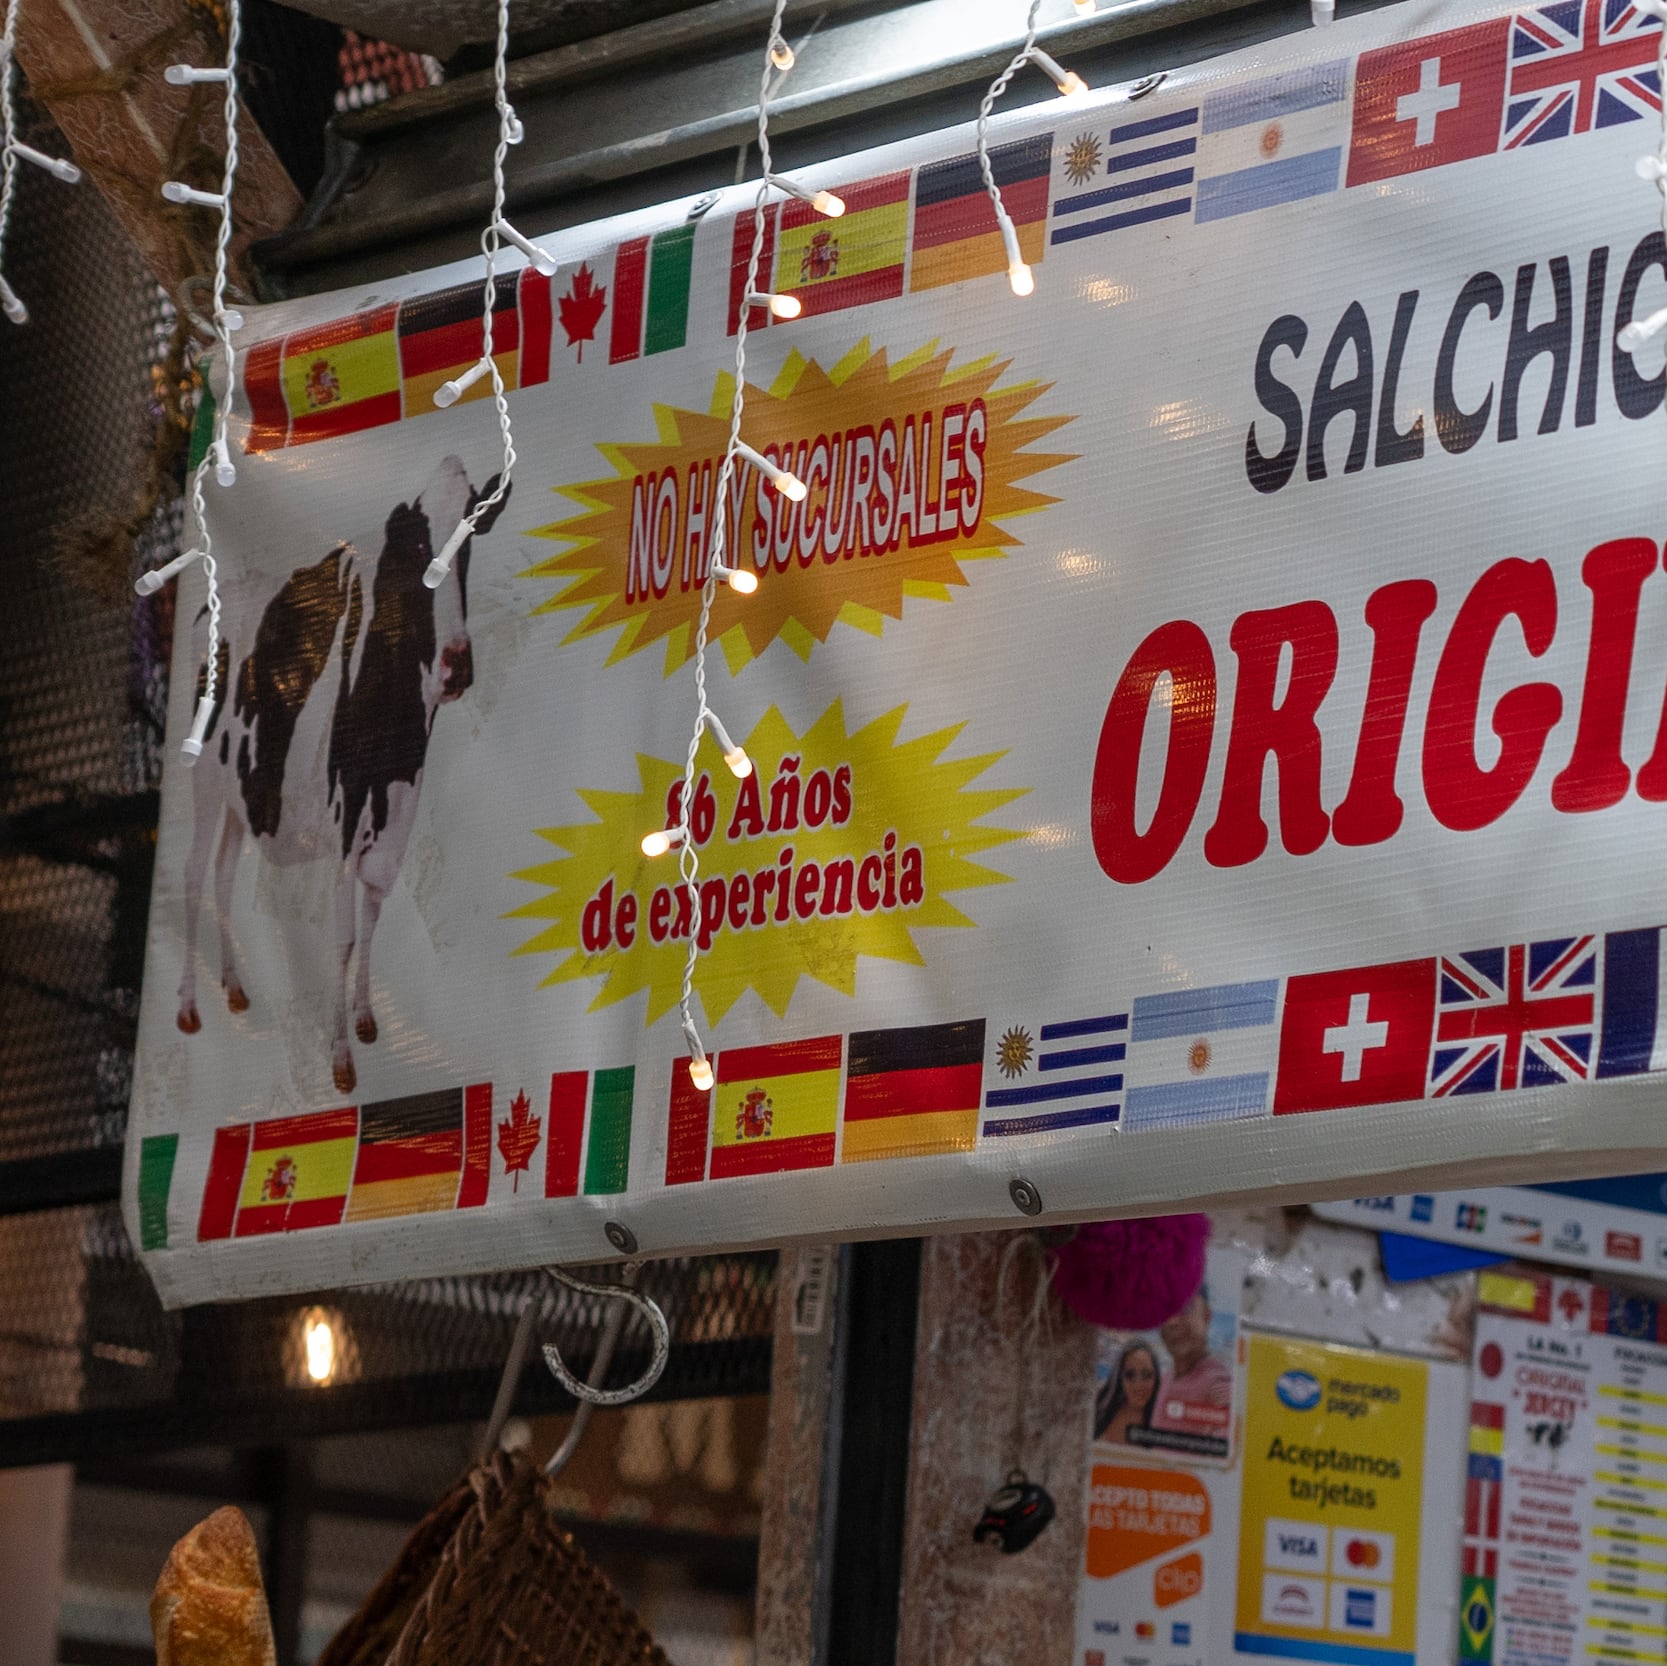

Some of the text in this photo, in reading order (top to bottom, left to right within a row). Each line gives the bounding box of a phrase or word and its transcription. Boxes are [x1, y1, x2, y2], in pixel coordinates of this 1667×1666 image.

[626, 397, 987, 605] NO HAY SUCURSALES
[728, 755, 853, 840] Años
[580, 831, 925, 953] de experiencia
[1326, 1377, 1402, 1403] mercado
[1326, 1396, 1370, 1420] pago
[1266, 1437, 1402, 1480] Aceptamos
[1288, 1476, 1378, 1510] tarjetas
[1278, 1533, 1319, 1557] VISA
